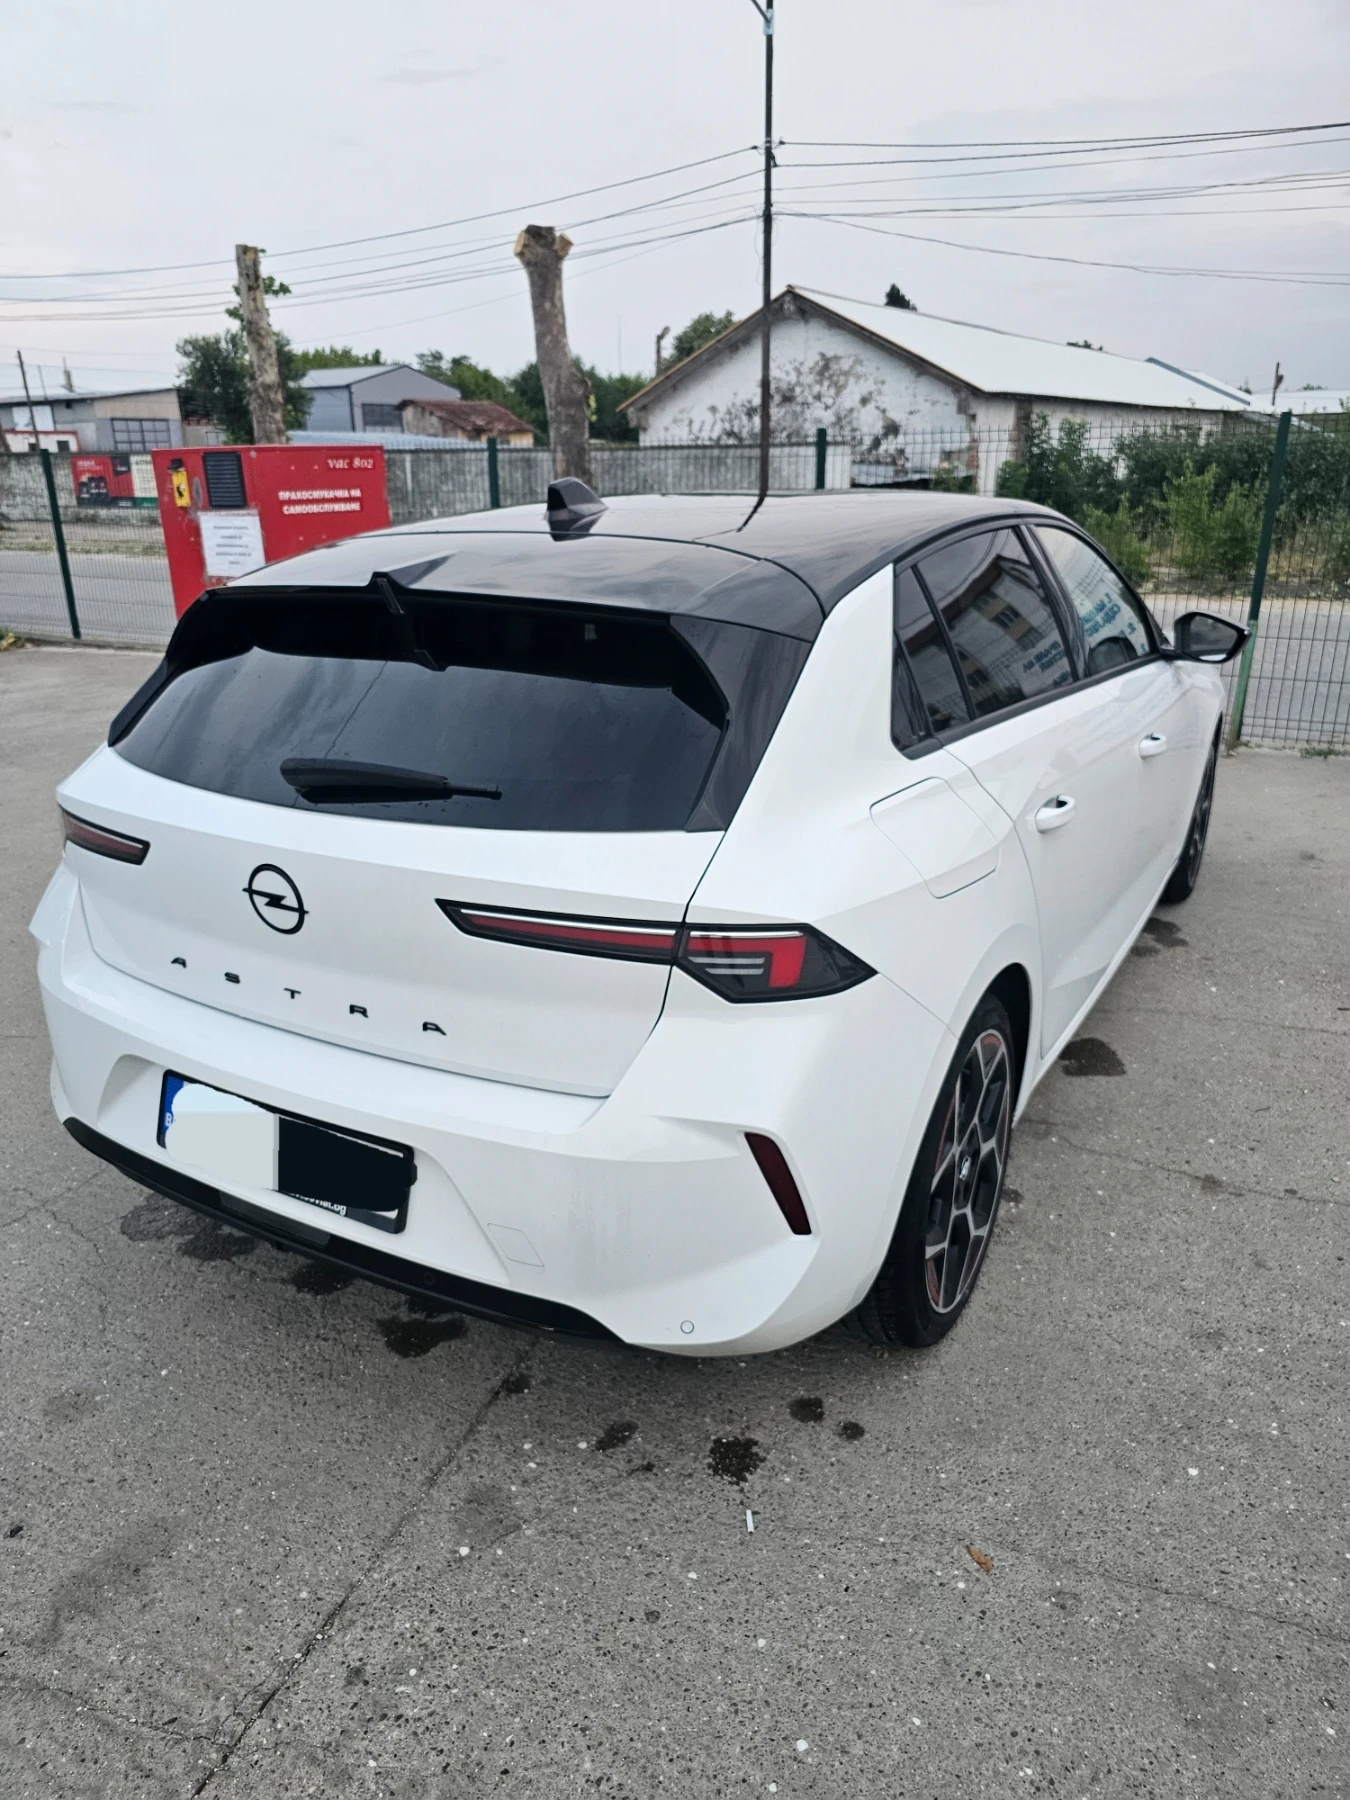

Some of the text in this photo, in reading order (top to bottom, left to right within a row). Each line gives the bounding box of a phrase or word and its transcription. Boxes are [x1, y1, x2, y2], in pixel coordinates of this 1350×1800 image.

[327, 456, 374, 469] vac 802
[170, 956, 447, 1036] ASTRA
